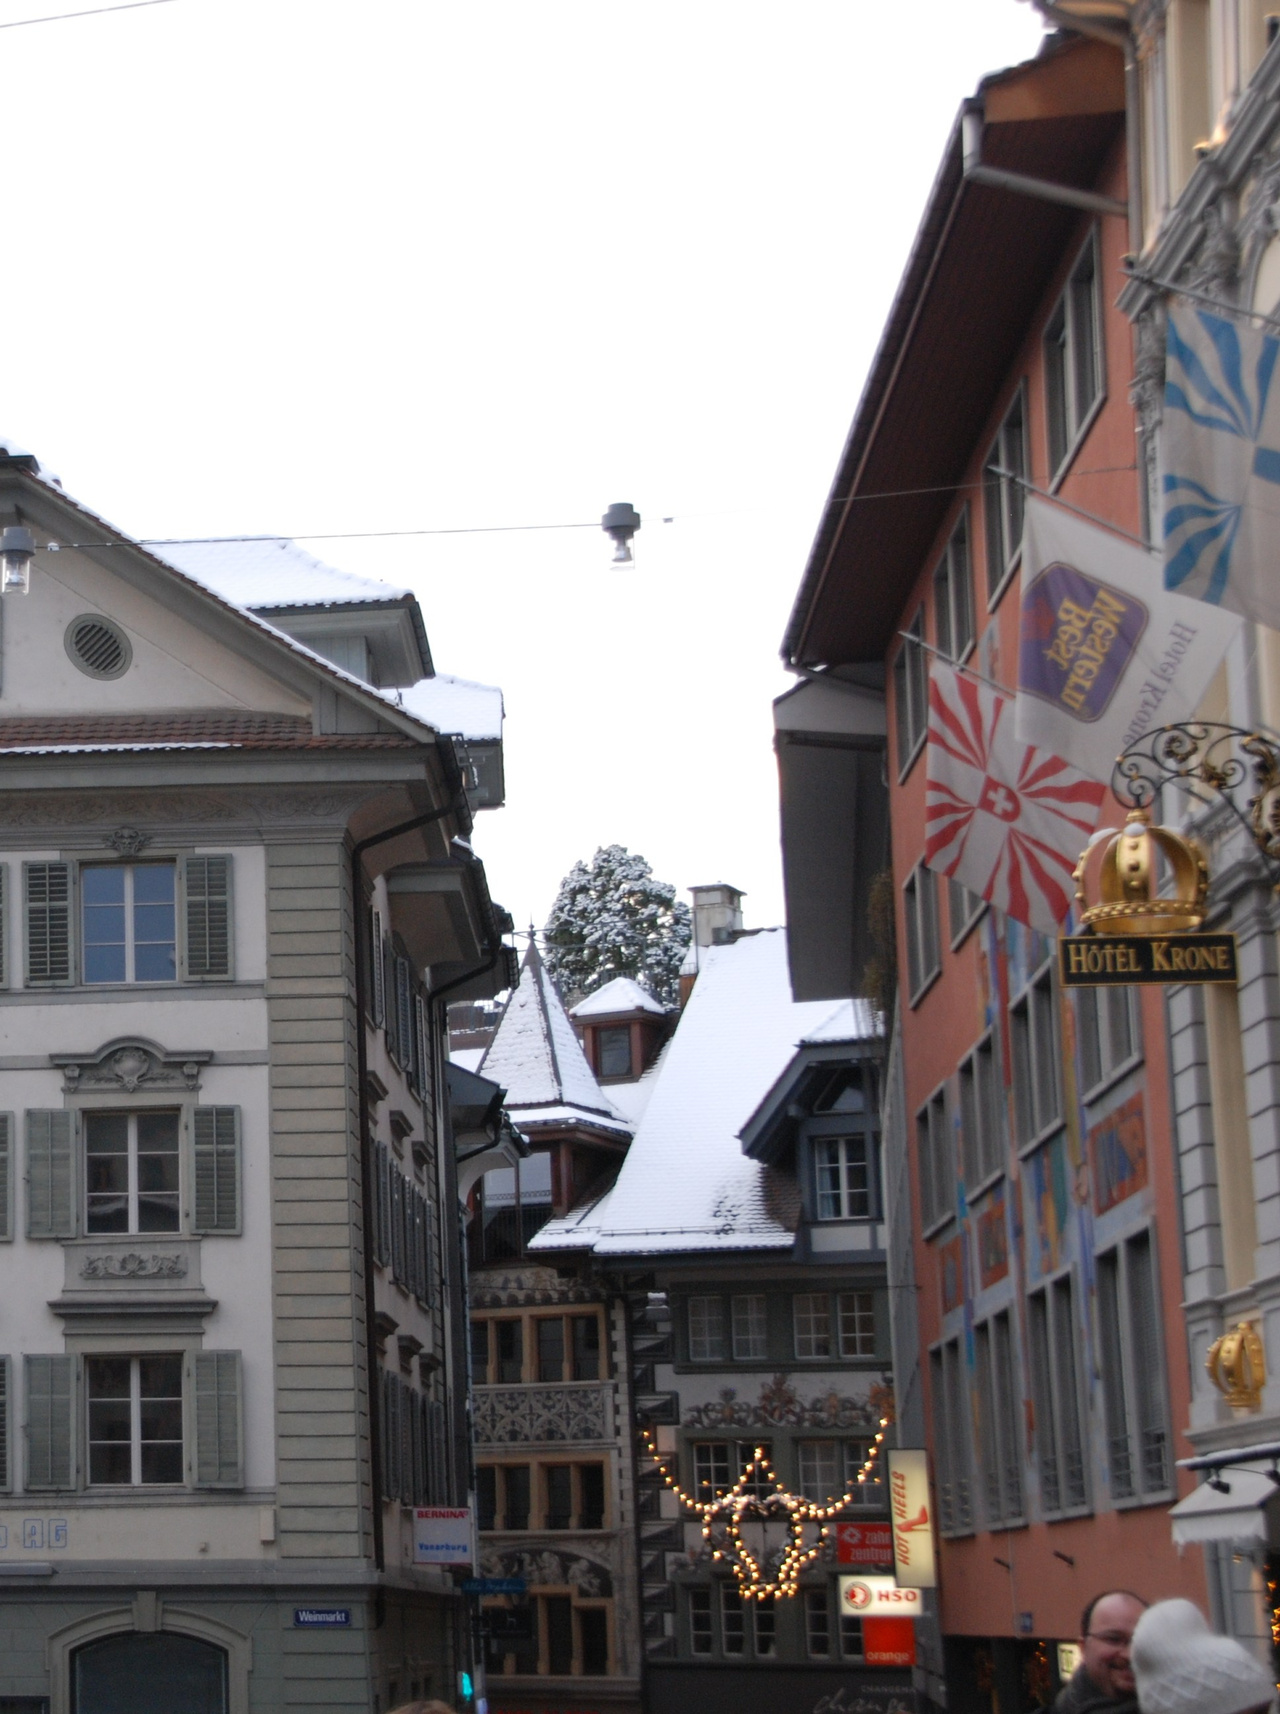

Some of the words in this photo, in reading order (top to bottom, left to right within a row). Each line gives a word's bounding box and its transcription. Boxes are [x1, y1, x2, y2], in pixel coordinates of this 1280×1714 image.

[1150, 941, 1230, 971] KRONE
[891, 1470, 907, 1520] HEELS
[23, 1519, 67, 1548] AG
[896, 1535, 911, 1566] HOT
[877, 1589, 918, 1602] HSO
[298, 1610, 346, 1622] Weinmarkt
[866, 1650, 910, 1664] orange
